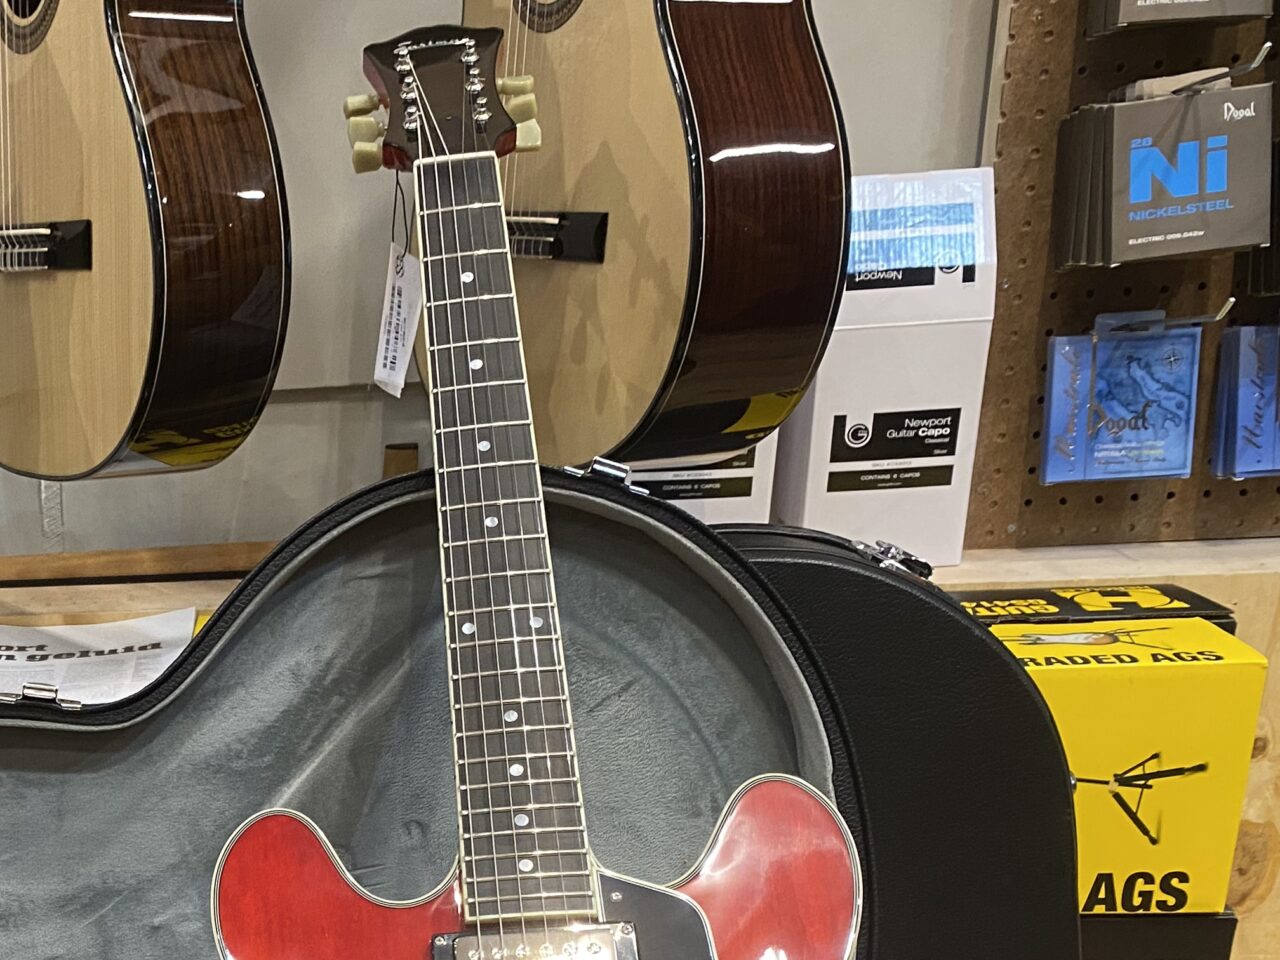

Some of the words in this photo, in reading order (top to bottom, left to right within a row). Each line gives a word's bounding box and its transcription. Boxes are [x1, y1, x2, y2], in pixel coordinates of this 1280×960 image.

[1224, 101, 1255, 121] Dogal
[1129, 135, 1228, 204] Ni
[1128, 199, 1234, 221] NICKELSTEEL
[1128, 234, 1165, 245] ELECTRIC
[855, 270, 902, 282] Newport
[905, 416, 951, 429] Newport
[887, 428, 918, 438] Guitar
[919, 427, 951, 437] Capo
[25, 642, 163, 661] geluid
[1152, 651, 1225, 664] AGS
[1081, 871, 1191, 913] AGS
